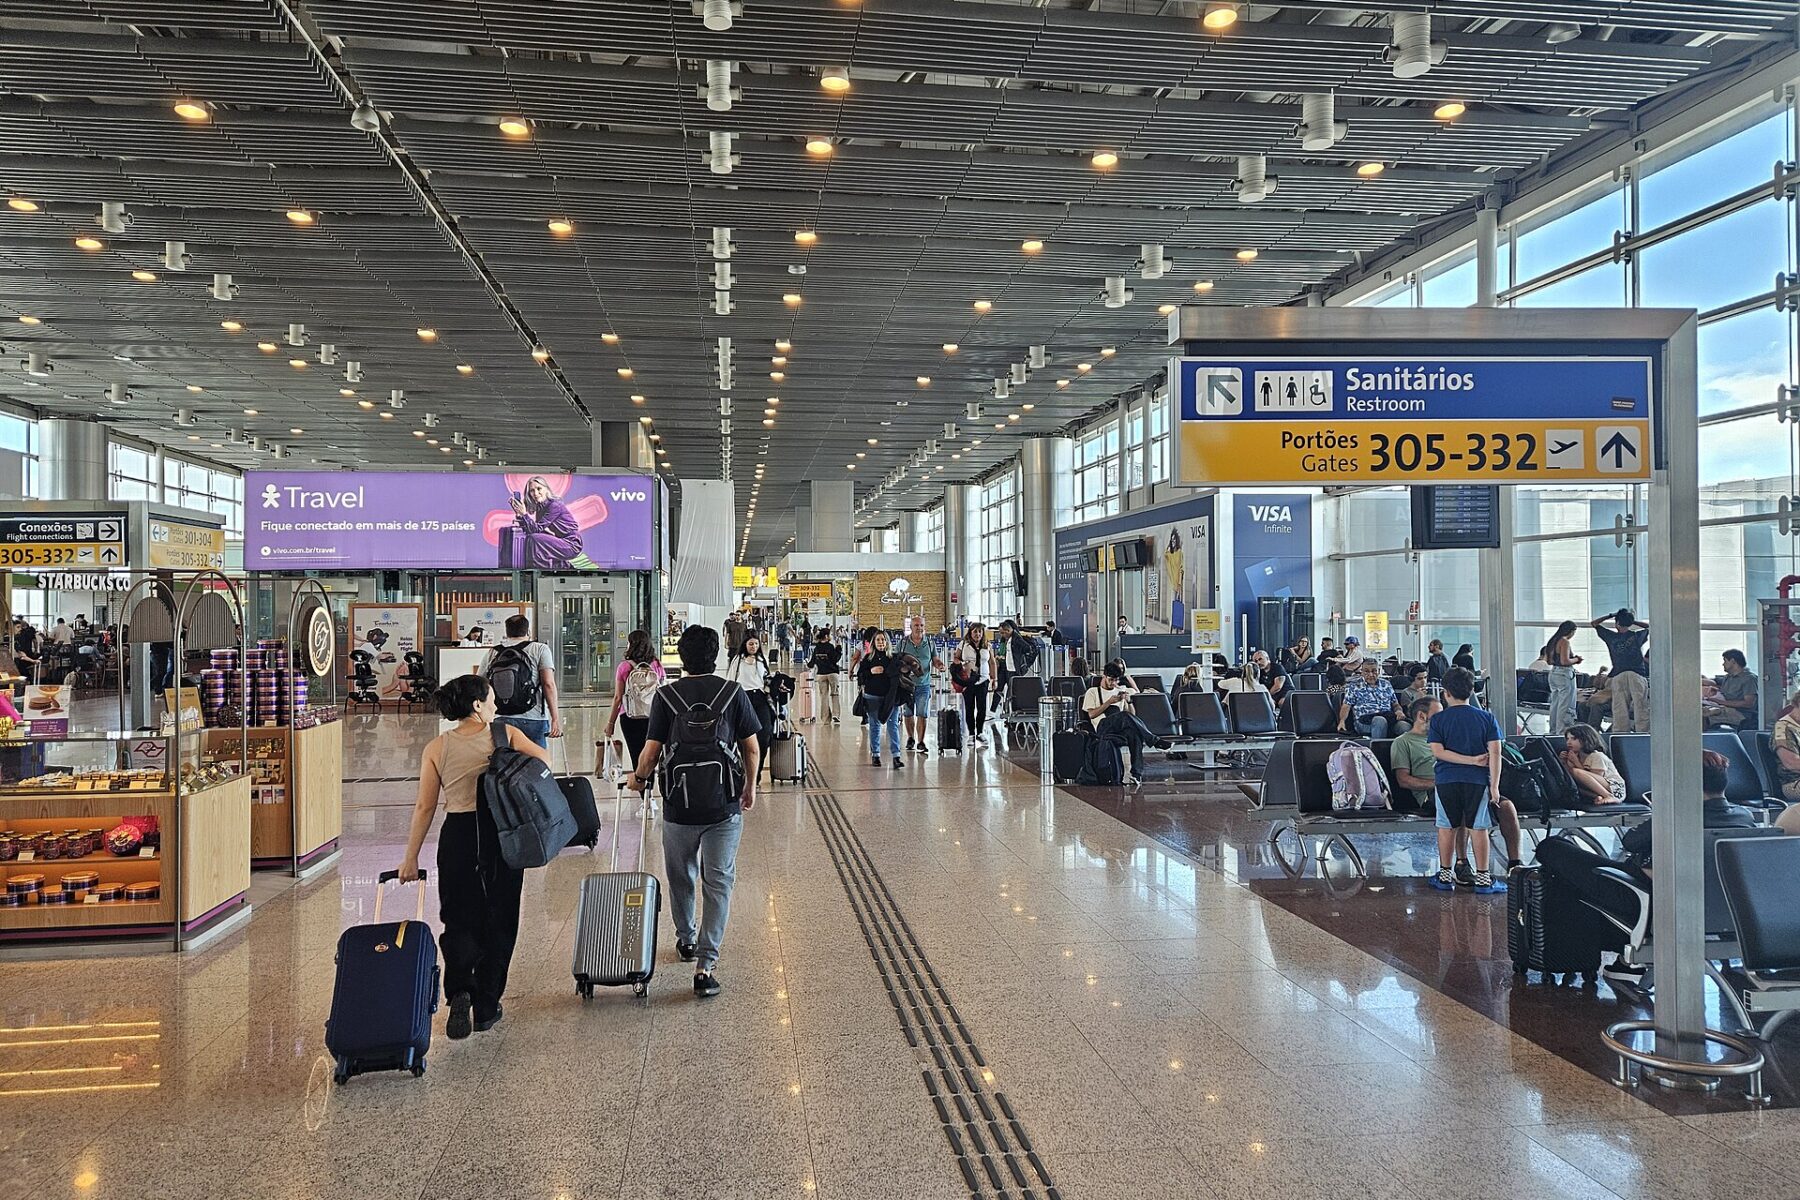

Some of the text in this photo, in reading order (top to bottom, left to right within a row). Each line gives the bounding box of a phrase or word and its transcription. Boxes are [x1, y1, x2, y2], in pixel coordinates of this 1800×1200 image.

[1346, 366, 1475, 391] Sanitários
[1347, 396, 1425, 411] Restroom
[1281, 430, 1358, 449] Portões
[1369, 433, 1538, 471] 305-332
[1301, 454, 1358, 472] Gates
[284, 486, 364, 508] Travel
[610, 488, 646, 501] vivo
[1248, 505, 1292, 521] VISA
[19, 522, 73, 532] Conexões
[261, 520, 475, 533] Fique conectado em mais de 175 países
[1190, 525, 1206, 538] VISA
[1264, 524, 1292, 533] Infinite
[7, 533, 28, 542] Flight
[185, 530, 212, 546] 301-304
[0, 548, 75, 564] 305-332
[181, 552, 208, 567] 305-332
[38, 573, 114, 591] STARBUCKS
